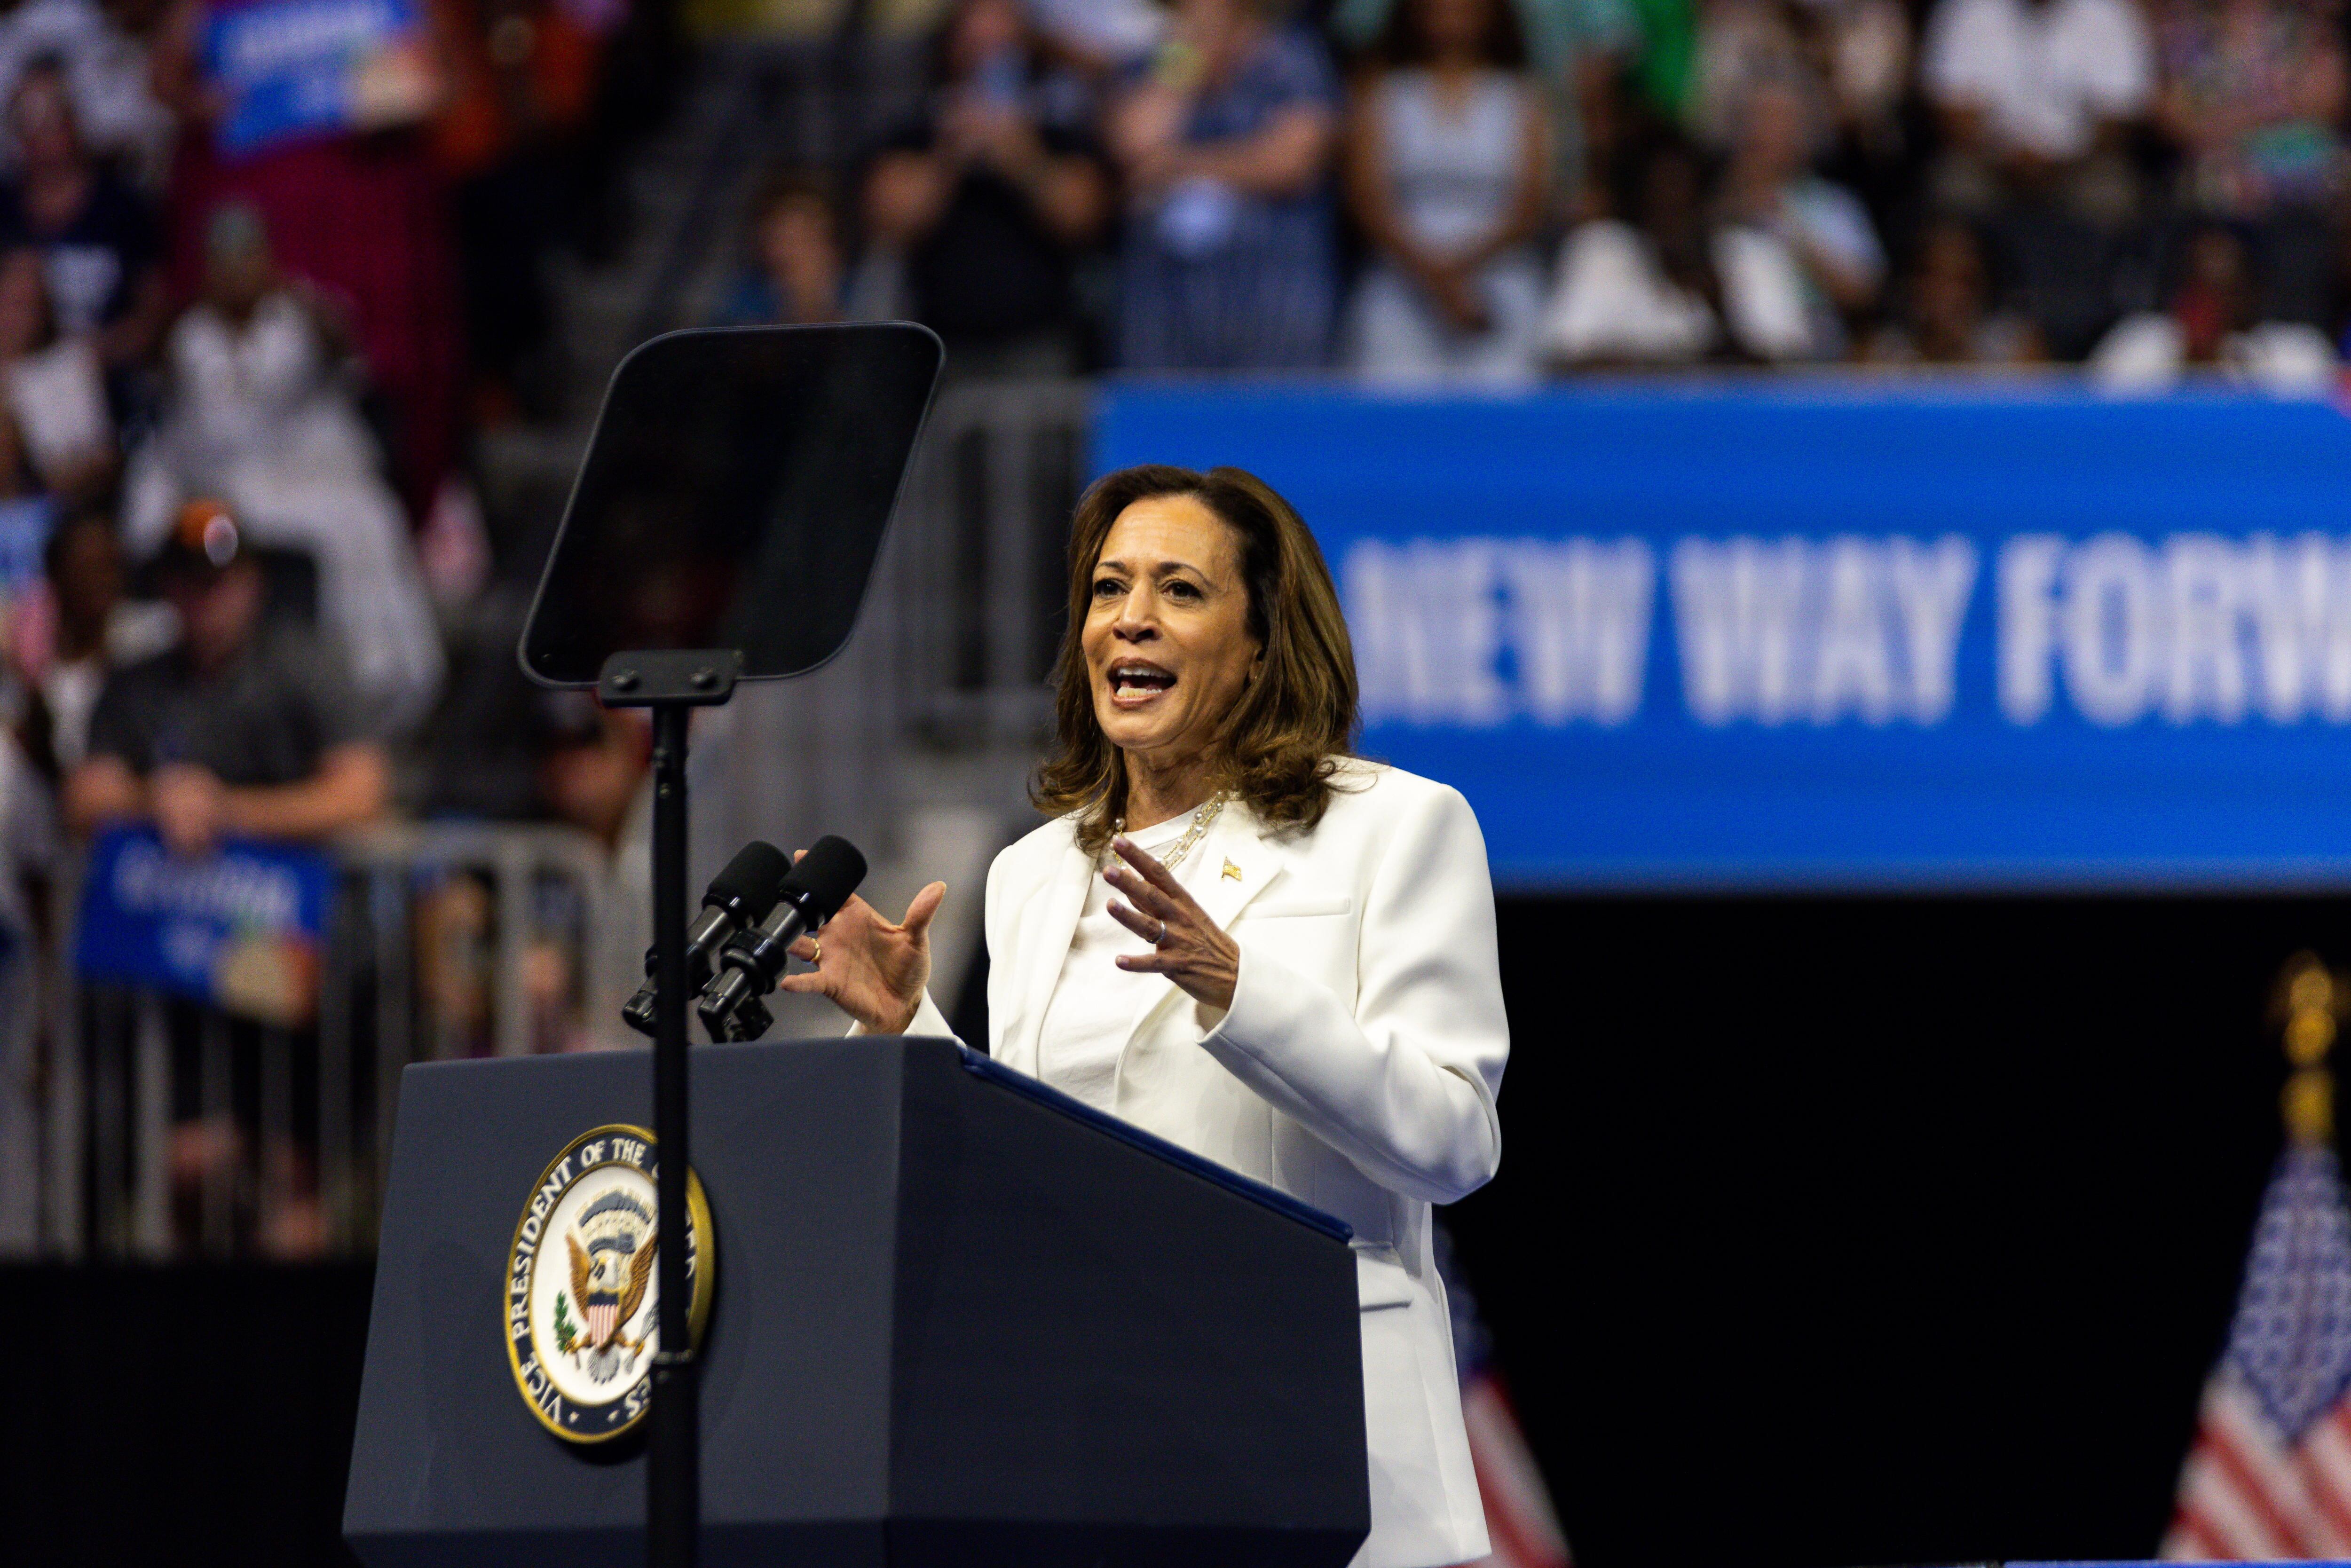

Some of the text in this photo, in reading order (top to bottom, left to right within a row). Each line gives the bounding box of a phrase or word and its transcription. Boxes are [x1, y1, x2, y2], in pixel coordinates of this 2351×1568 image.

[1348, 535, 2351, 724] NEW WAY FORW
[511, 1138, 646, 1423] VICE PRESIDENT OF THE
